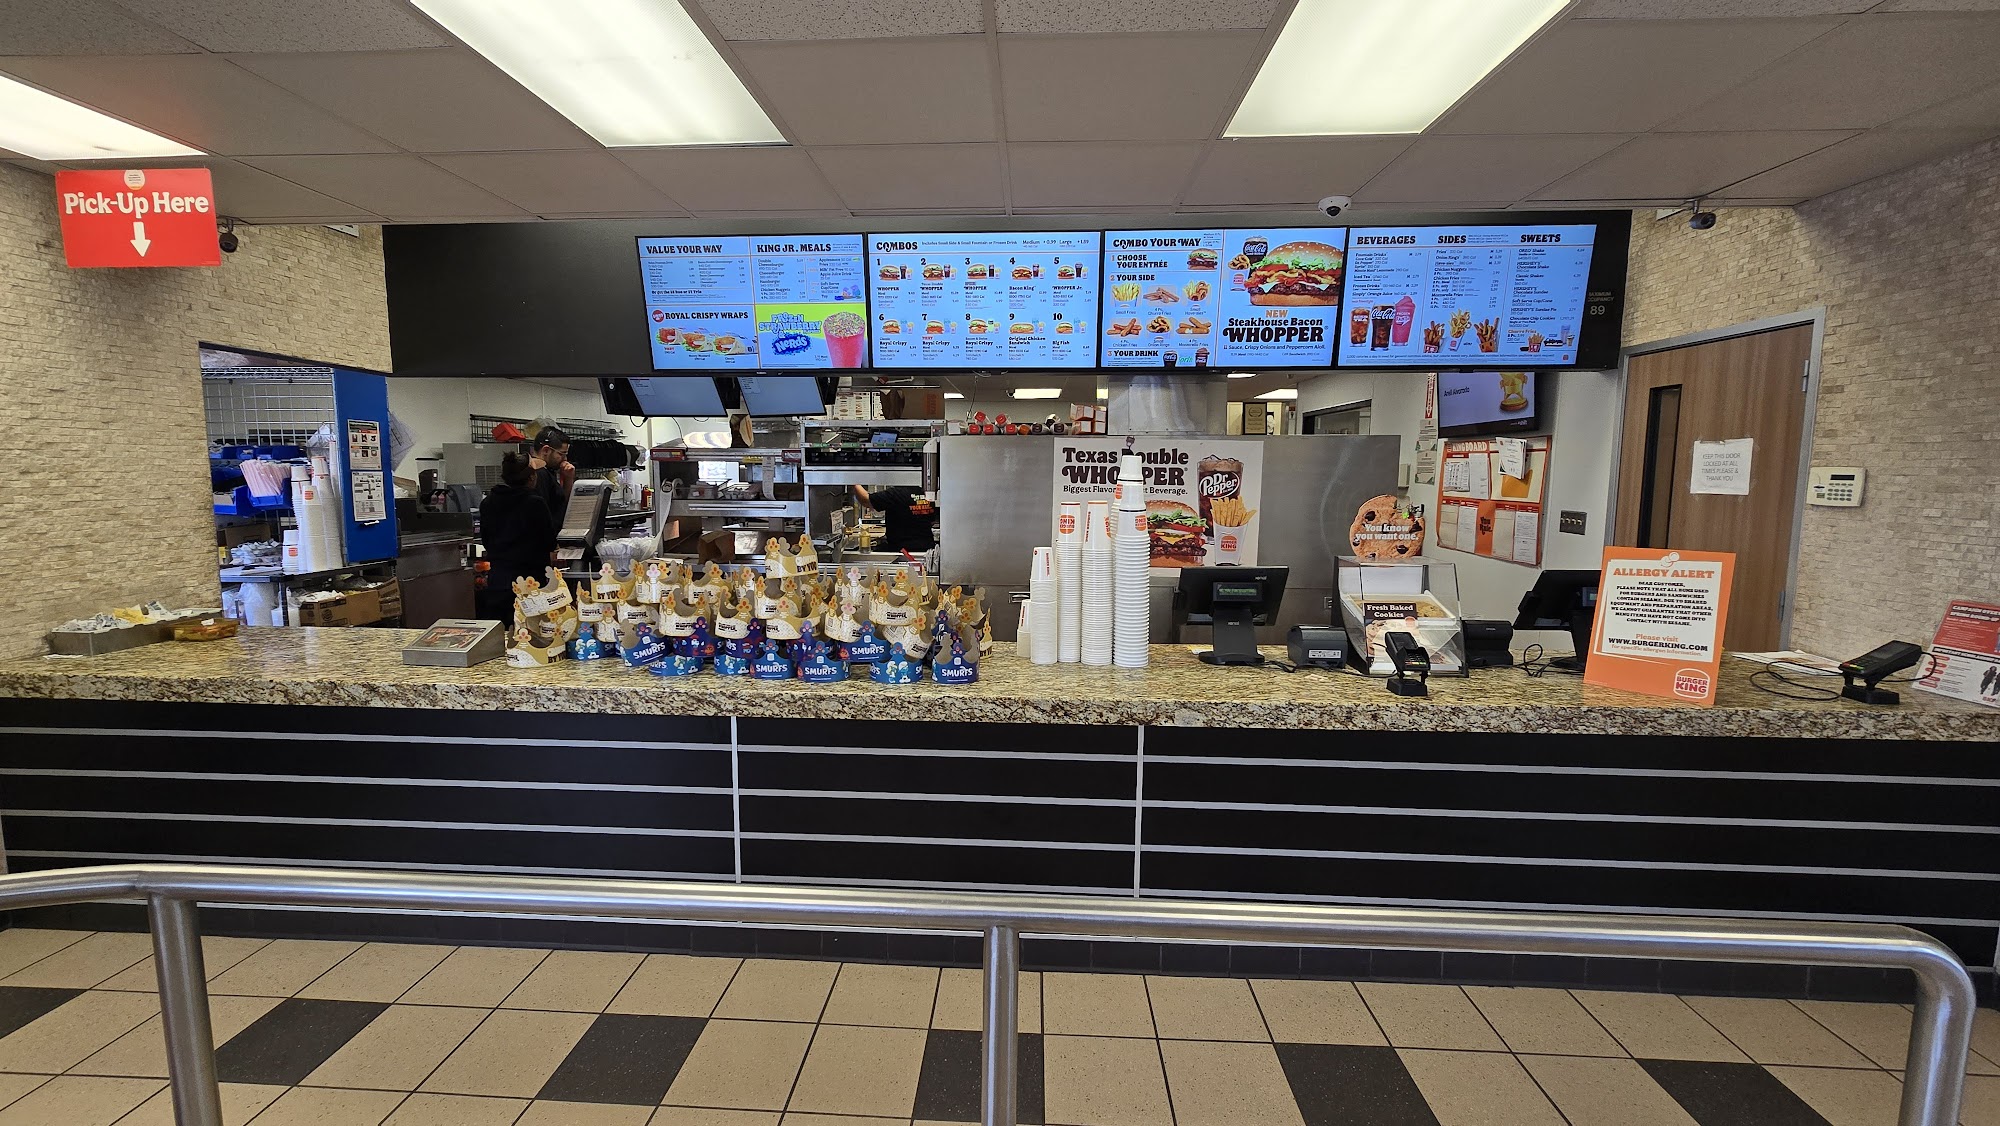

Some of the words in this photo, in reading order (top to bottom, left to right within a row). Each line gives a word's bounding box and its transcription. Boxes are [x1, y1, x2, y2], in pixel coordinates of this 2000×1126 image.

[64, 192, 150, 218] Pick-Up
[152, 192, 209, 214] Here
[1357, 236, 1416, 244] BEVERAGES
[1438, 235, 1466, 244] SIDES
[1520, 234, 1560, 242] SWEETS
[757, 244, 780, 252] KING
[782, 244, 798, 252] JR.
[800, 244, 831, 252] MEALS
[876, 242, 918, 252] COMBOS
[1113, 239, 1148, 249] COMBO
[1150, 238, 1177, 247] YOUR
[1178, 238, 1201, 246] WAY
[646, 245, 675, 254] VALUE
[677, 245, 702, 253] YOUR
[703, 244, 722, 253] WAY
[1139, 260, 1168, 268] ENTRÉE
[1266, 309, 1288, 317] NEW
[1590, 305, 1605, 315] 89
[1228, 318, 1288, 326] Steakhouse
[1291, 318, 1322, 326] Bacon
[1063, 447, 1117, 463] Texas
[1213, 473, 1228, 485] Dr
[1063, 486, 1091, 494] Biggest
[1200, 476, 1238, 496] Pepper
[807, 561, 817, 571] YOU
[1613, 568, 1670, 577] ALLERGY
[1671, 569, 1714, 578] ALERT
[852, 643, 884, 654] SMURFS
[1608, 638, 1708, 651] WWW.BURGERKING.COM
[633, 642, 666, 659] SMURFS
[756, 662, 787, 672] SMURFS
[805, 665, 837, 675] SMURFS
[942, 666, 973, 677] SMURFS
[1676, 676, 1708, 686] BURGER
[1675, 682, 1707, 693] KING
